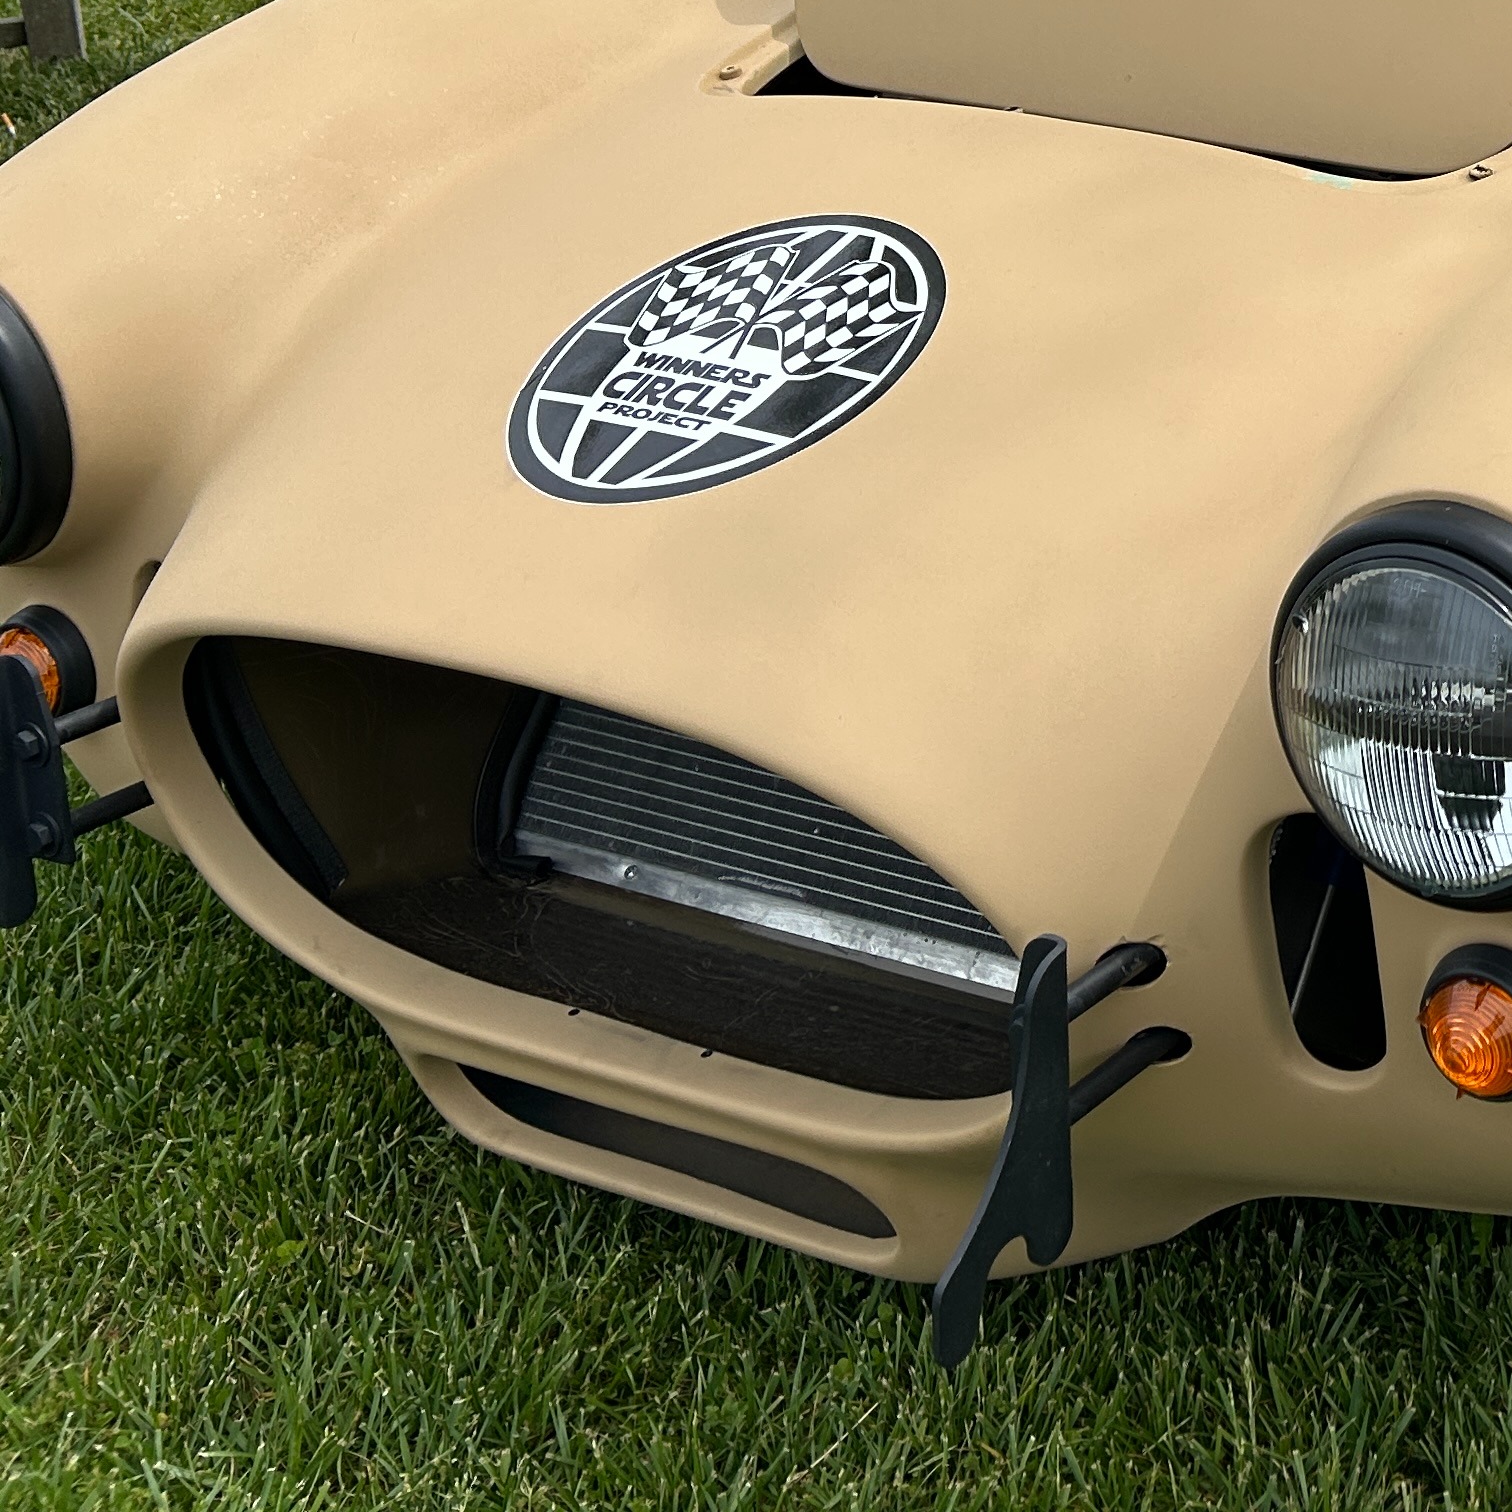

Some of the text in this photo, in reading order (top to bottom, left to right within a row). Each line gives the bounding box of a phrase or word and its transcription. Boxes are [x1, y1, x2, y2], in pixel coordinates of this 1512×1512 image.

[633, 351, 772, 389] WINNERS
[602, 371, 752, 421] CIRCLE
[596, 401, 712, 431] PROJECT
